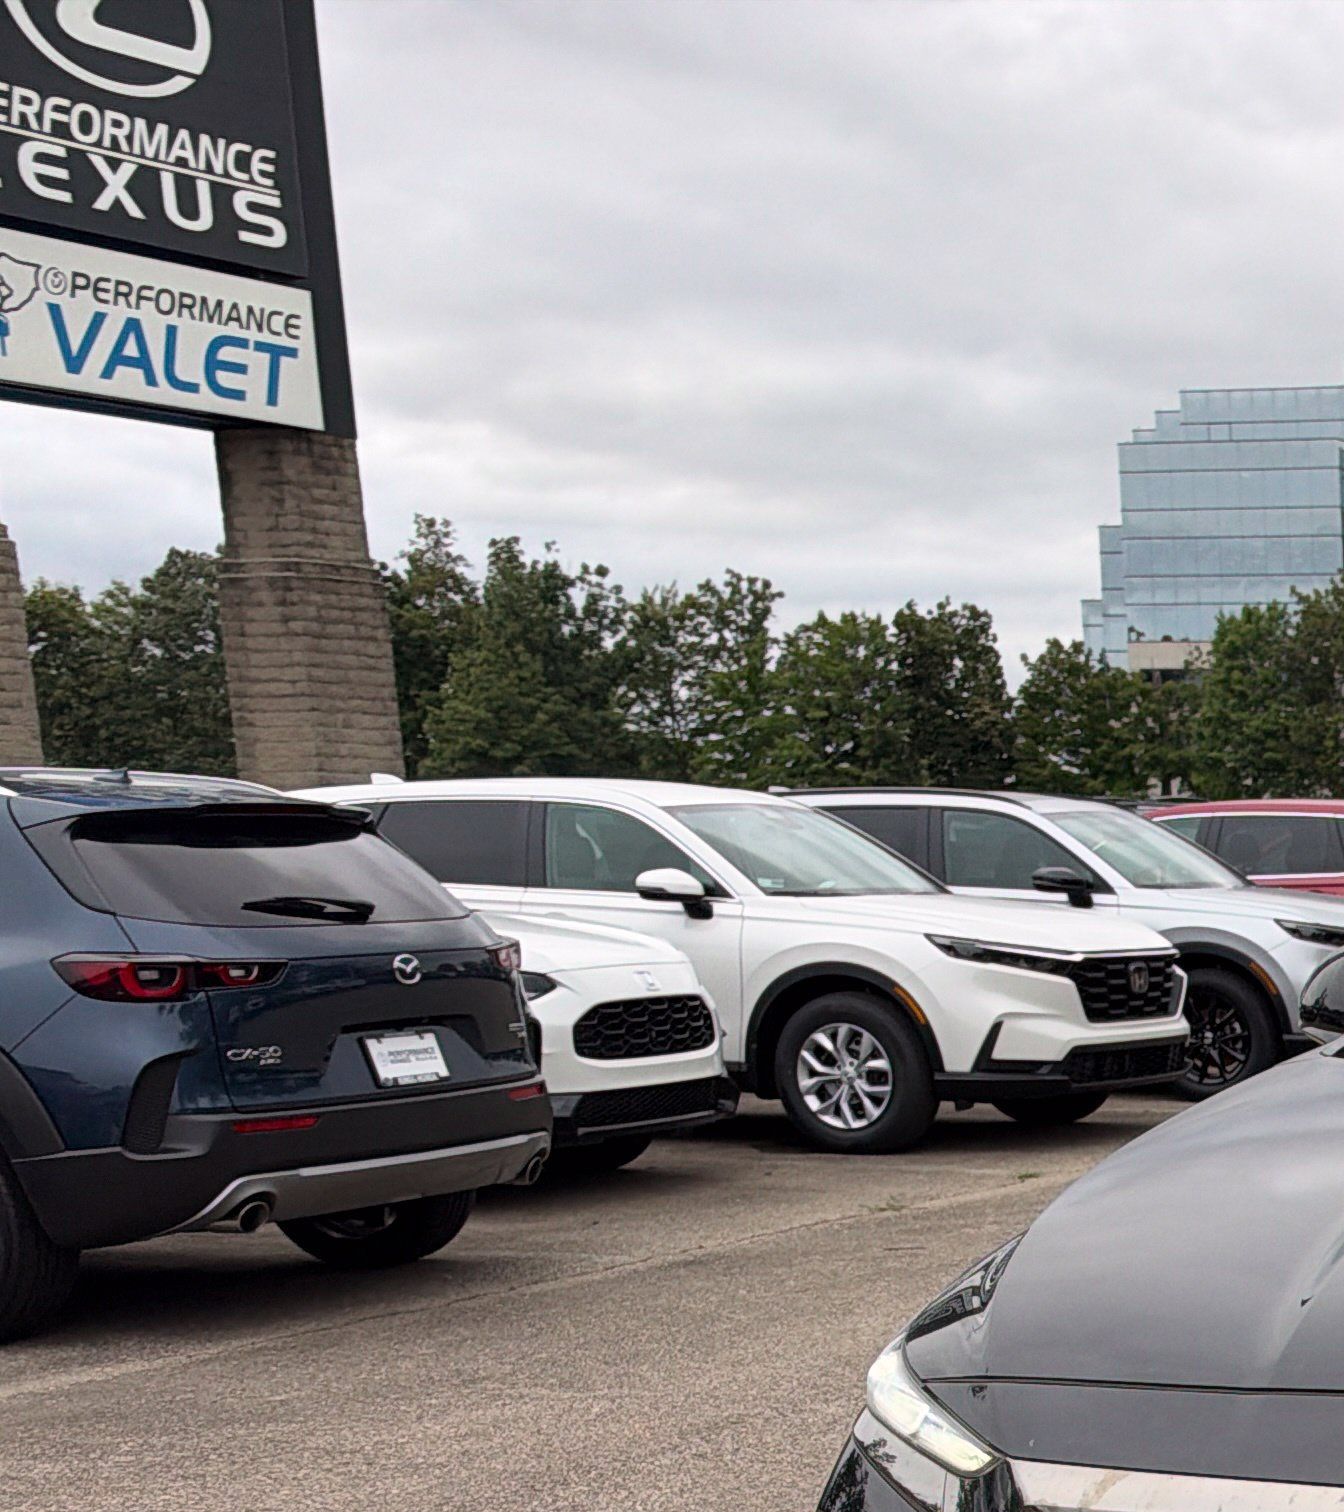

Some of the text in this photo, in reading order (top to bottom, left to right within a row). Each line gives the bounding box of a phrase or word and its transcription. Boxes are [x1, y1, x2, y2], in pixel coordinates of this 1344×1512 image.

[0, 140, 287, 249] EXUS
[45, 301, 299, 408] VALET
[69, 270, 302, 341] PERFORMANCE
